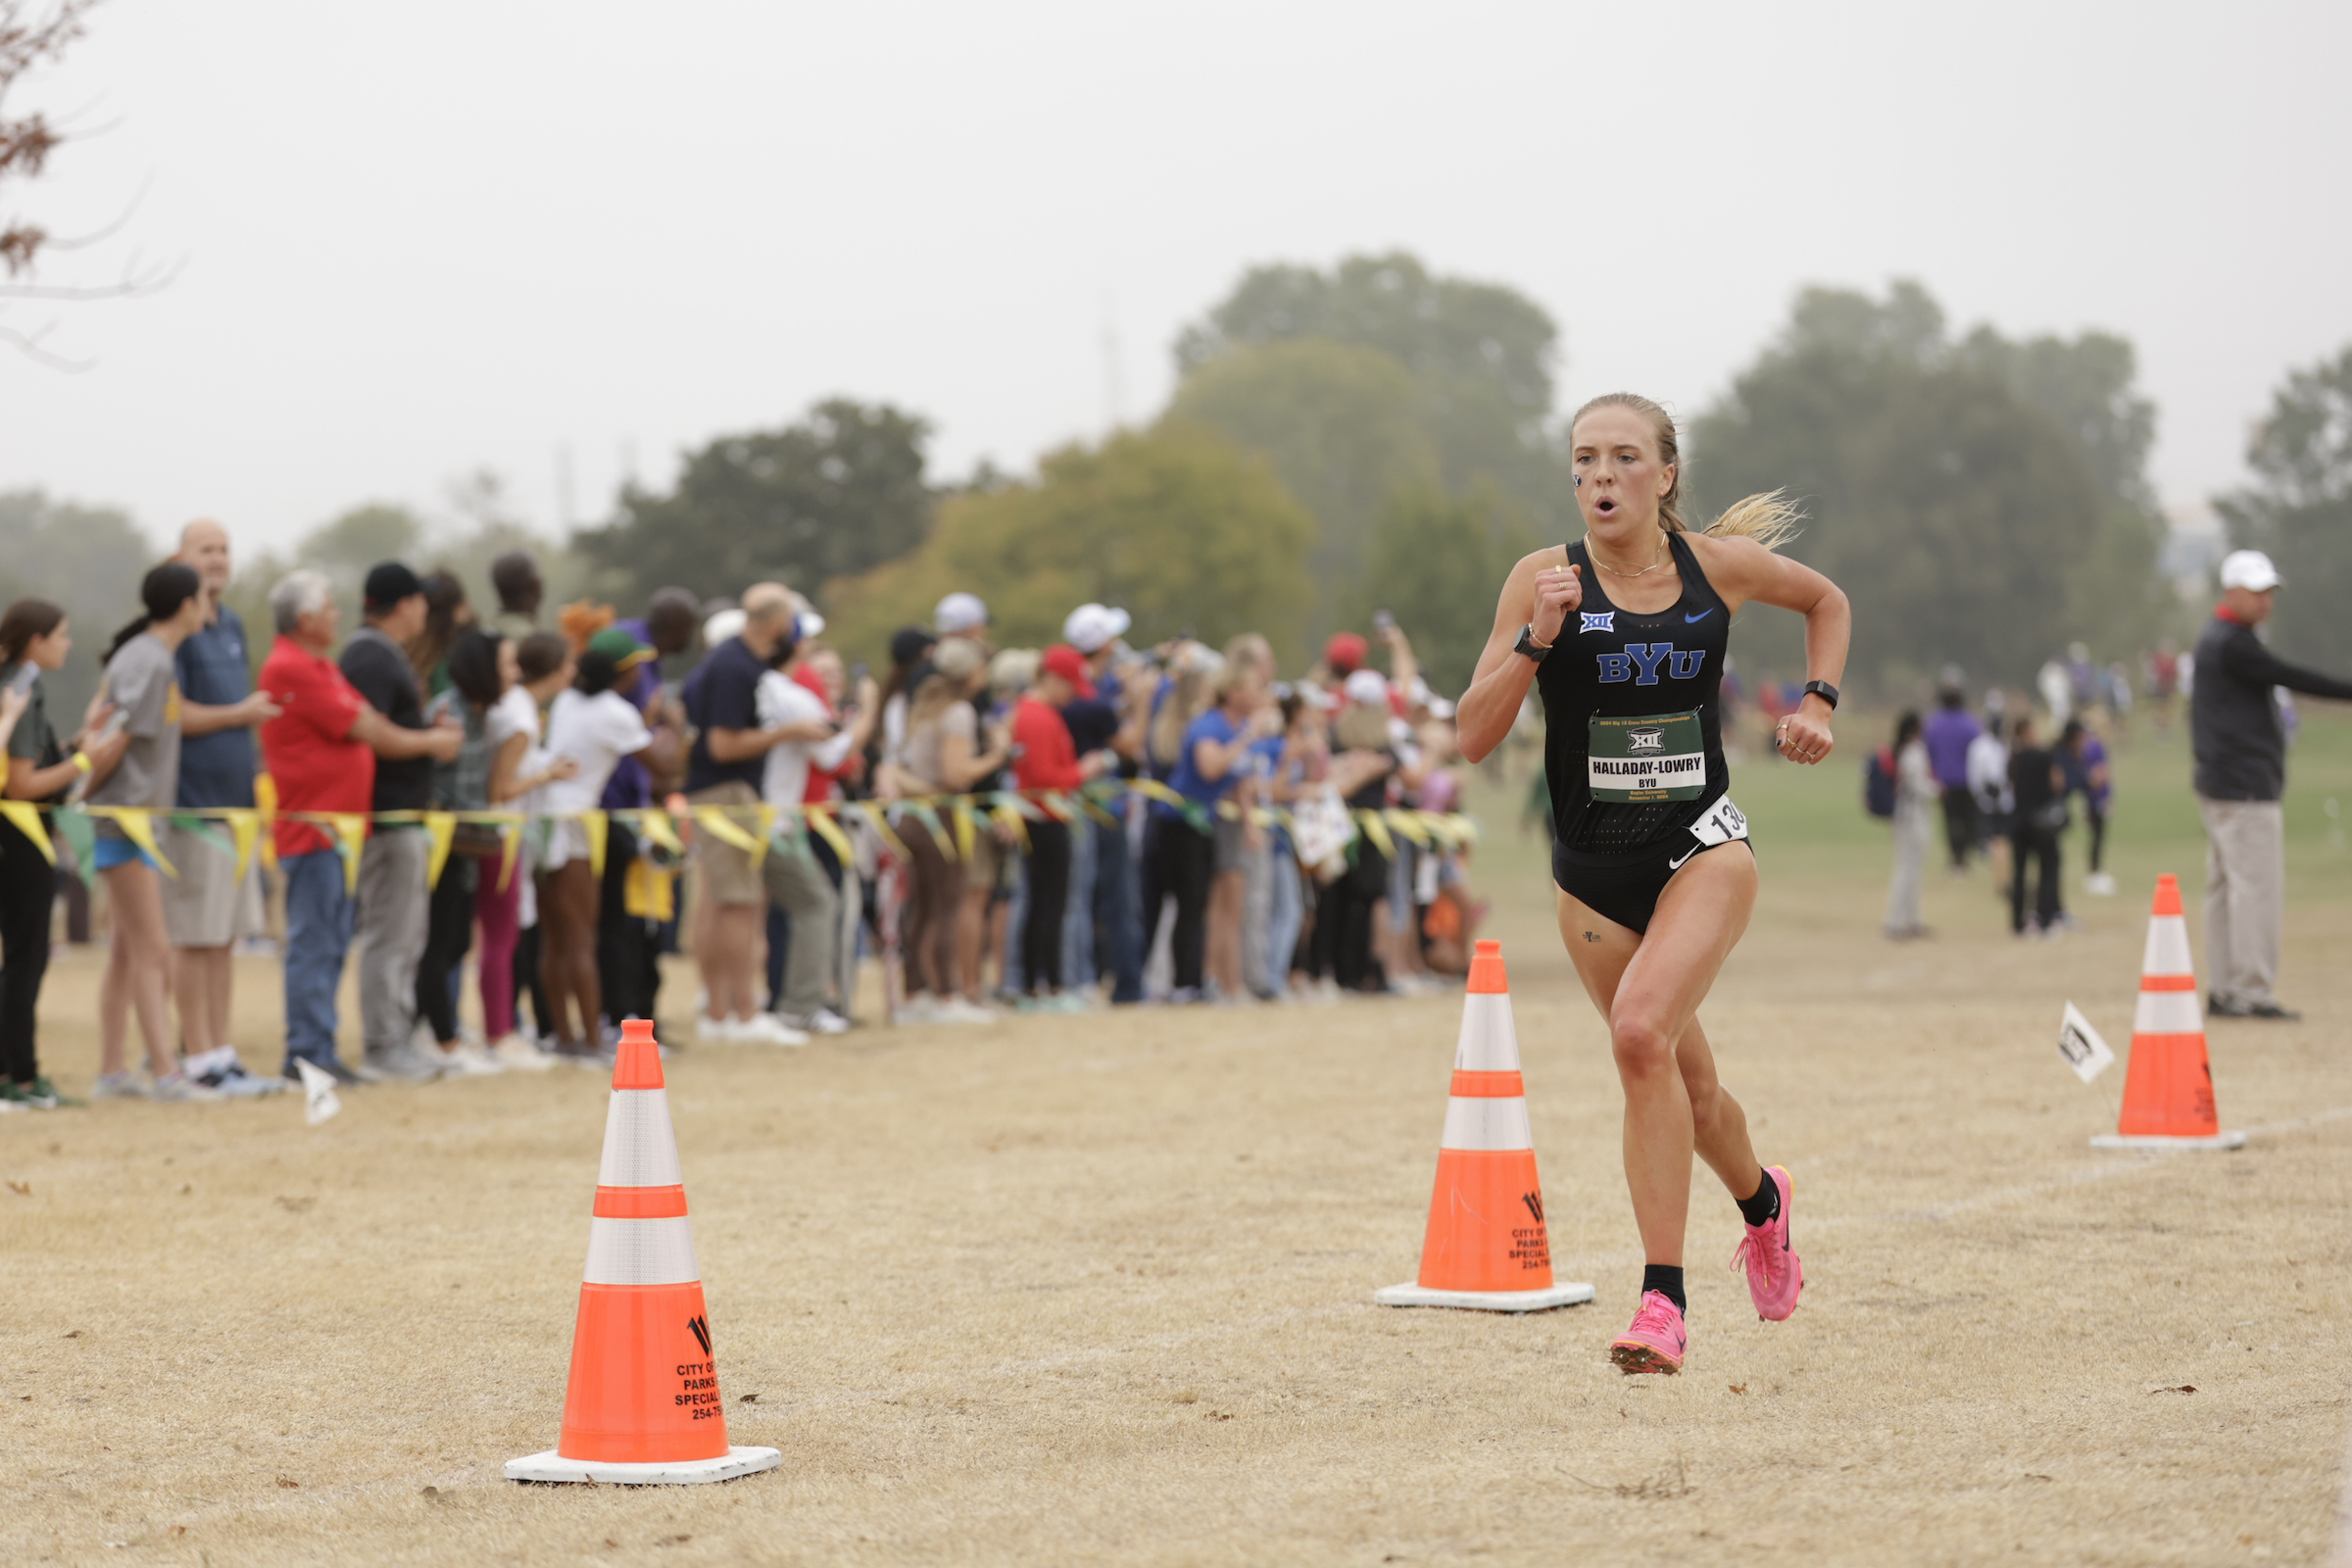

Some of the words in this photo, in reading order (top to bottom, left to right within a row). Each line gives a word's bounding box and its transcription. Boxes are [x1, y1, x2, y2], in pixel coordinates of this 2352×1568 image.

[1596, 642, 1706, 685] BYU
[1593, 757, 1701, 775] HALLADAY-LOWRY
[1639, 778, 1657, 788] BYU
[676, 1363, 704, 1376] CITY
[683, 1376, 715, 1391] PARKS
[674, 1392, 718, 1406] SPECIAL
